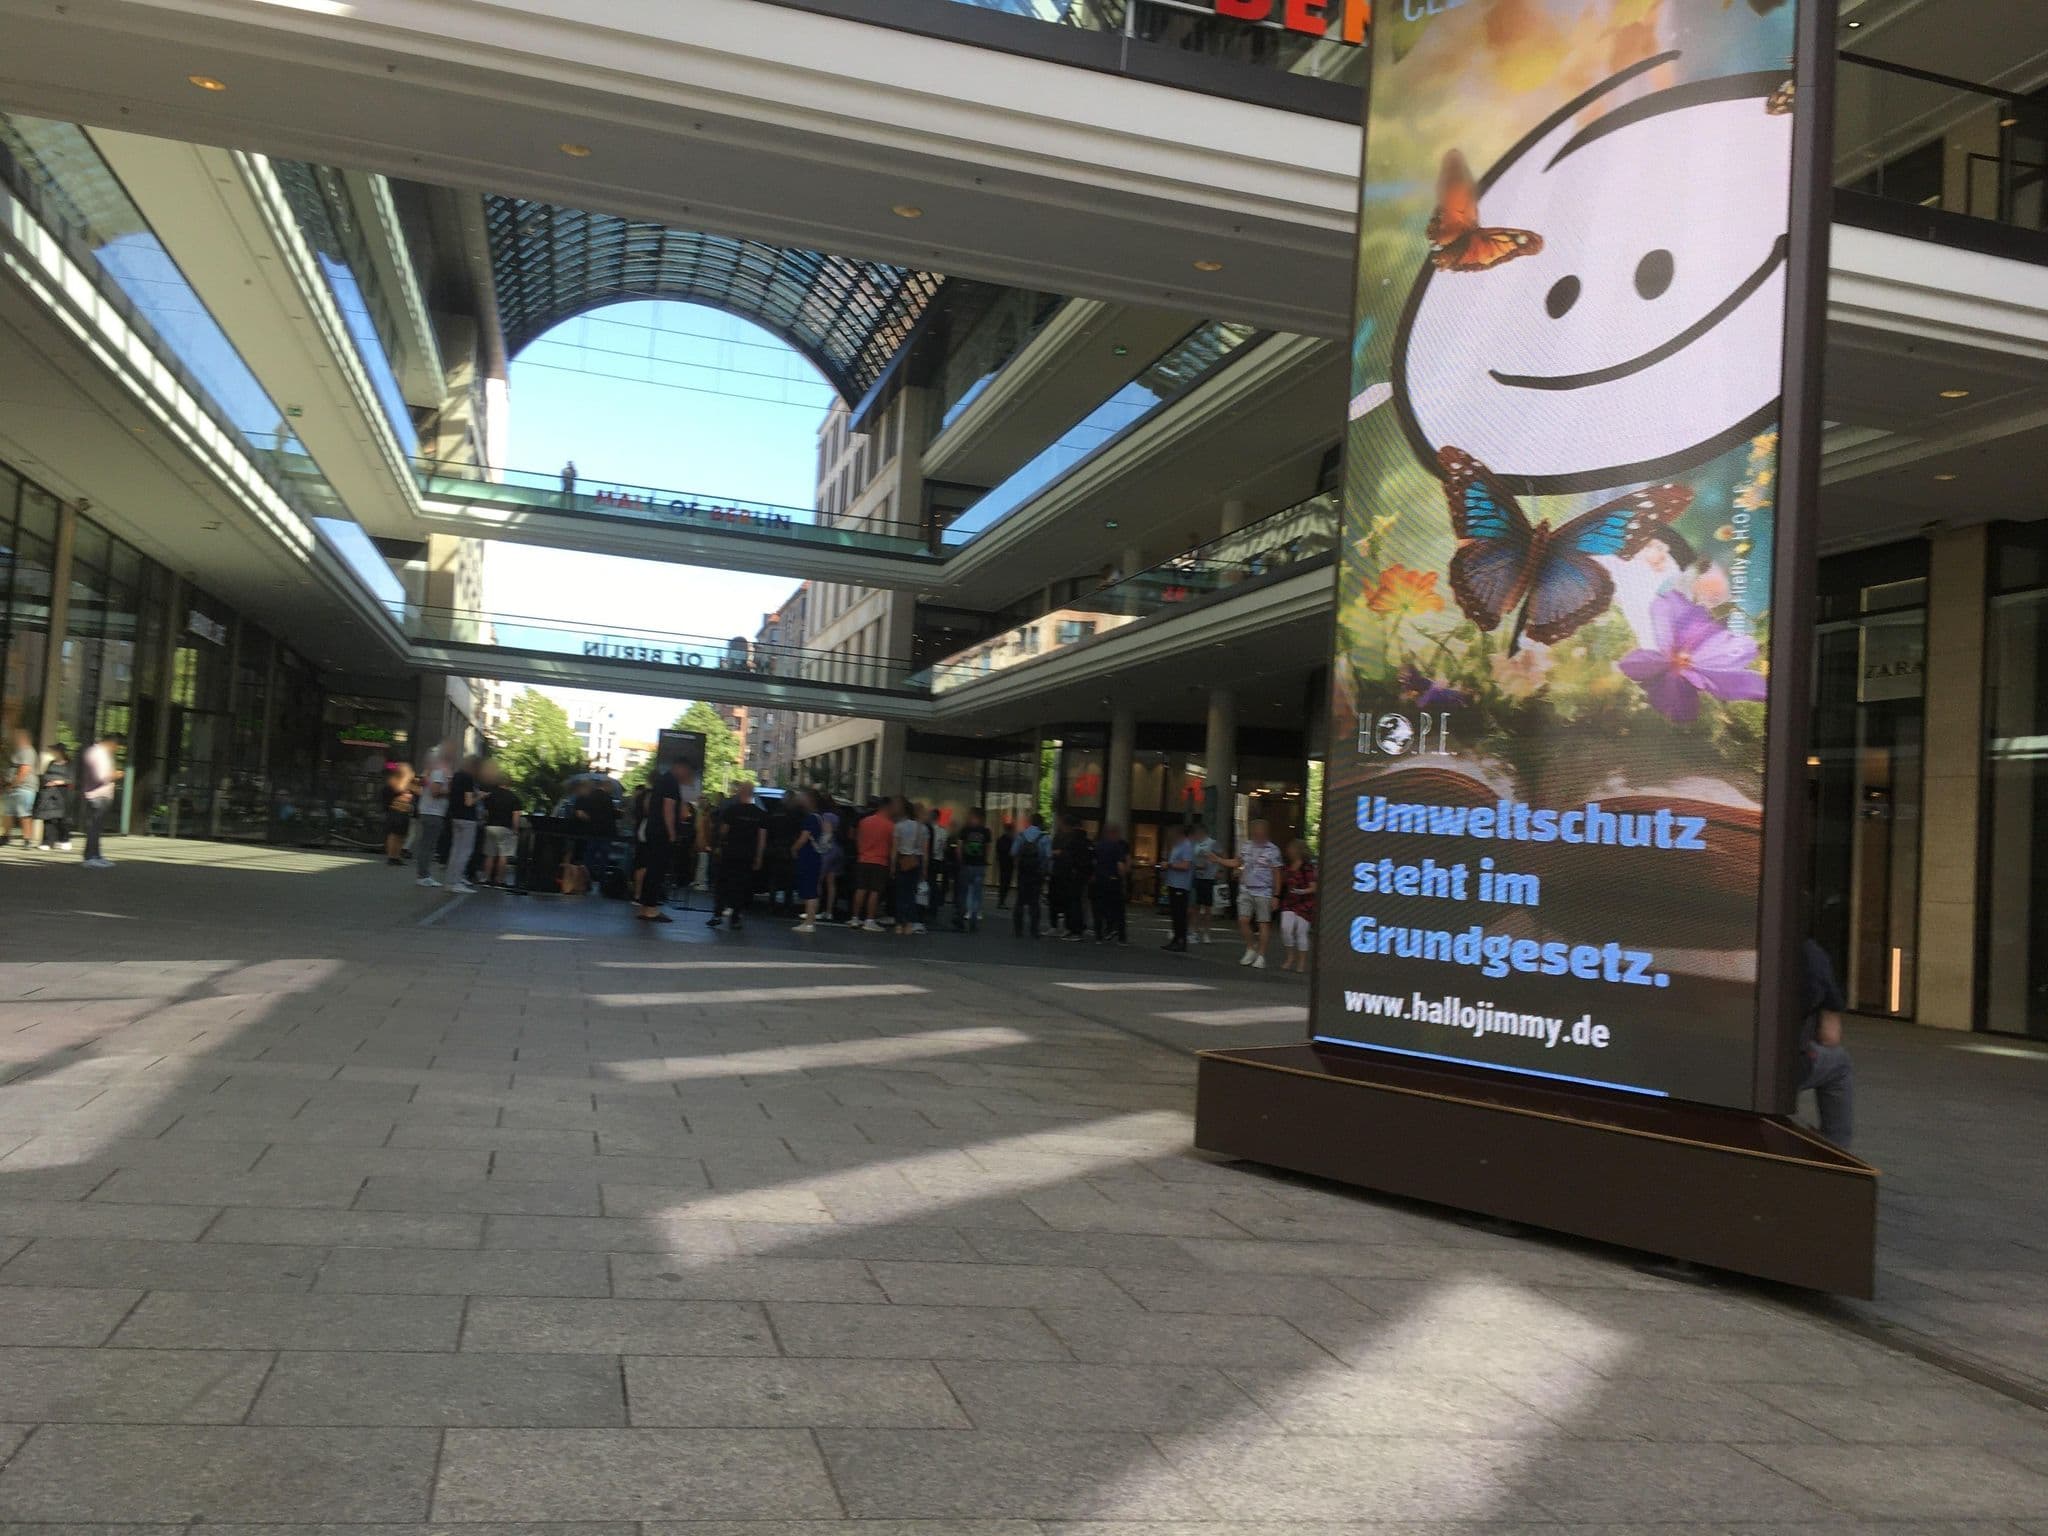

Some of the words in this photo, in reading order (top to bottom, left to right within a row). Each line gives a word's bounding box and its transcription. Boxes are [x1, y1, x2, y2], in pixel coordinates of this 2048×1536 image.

[670, 499, 699, 519] OF
[711, 504, 791, 529] BERLIN
[1356, 795, 1708, 850] Umweltschutz
[1352, 858, 1468, 901] steht
[1478, 857, 1540, 906] im
[1349, 915, 1671, 989] Grundgesetz.
[1344, 987, 1611, 1049] www.hallojimmy.de
